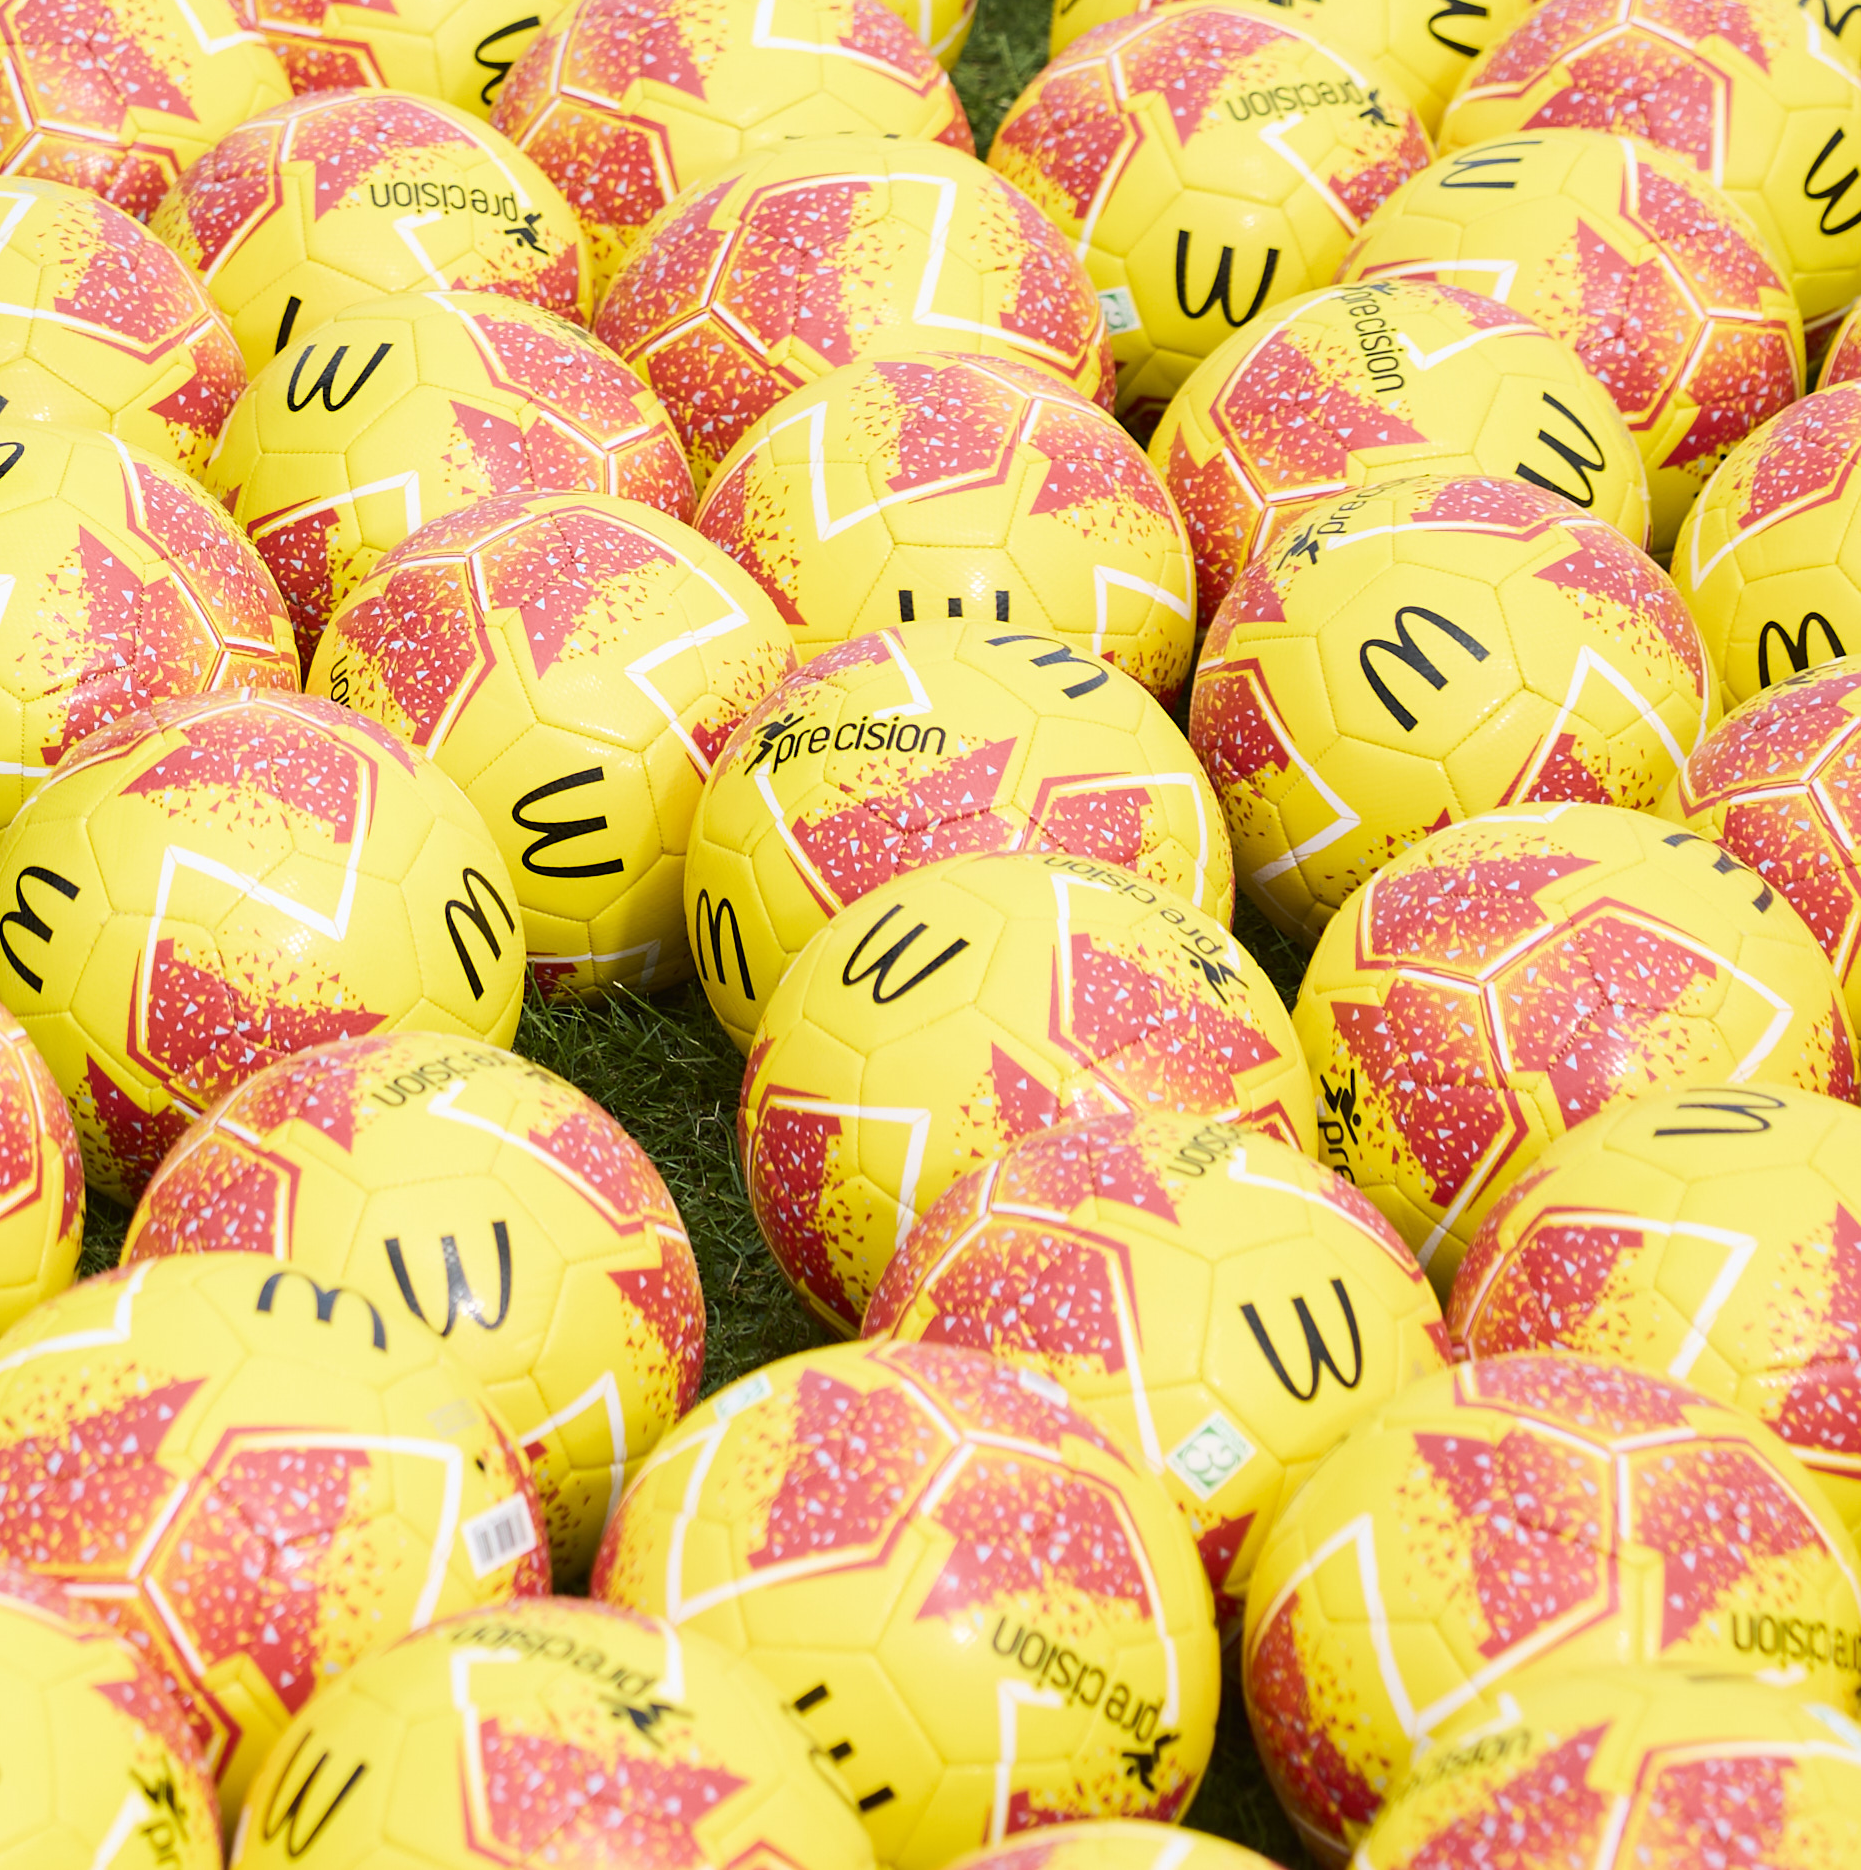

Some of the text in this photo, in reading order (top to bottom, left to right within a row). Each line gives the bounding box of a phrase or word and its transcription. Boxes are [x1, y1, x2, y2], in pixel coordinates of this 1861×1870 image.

[1228, 83, 1365, 123] precision
[372, 182, 519, 224] precision
[1439, 139, 1543, 190] M
[1804, 128, 1861, 236] M
[1176, 230, 1279, 328] M
[287, 343, 393, 412] M
[1337, 284, 1405, 394] precision
[1516, 392, 1605, 508] M
[986, 636, 1108, 698] M
[1360, 606, 1489, 732] M
[772, 717, 946, 771] precision
[512, 767, 624, 878] M
[0, 866, 80, 994] M
[445, 868, 515, 1001] M
[697, 888, 756, 1002] M
[843, 905, 969, 1004] M
[1043, 853, 1226, 963] precision
[257, 1274, 385, 1349] M
[385, 1222, 511, 1337] M
[1241, 1279, 1362, 1401] M
[451, 1620, 661, 1701] precision
[993, 1616, 1163, 1743] precision
[263, 1729, 368, 1858] M
